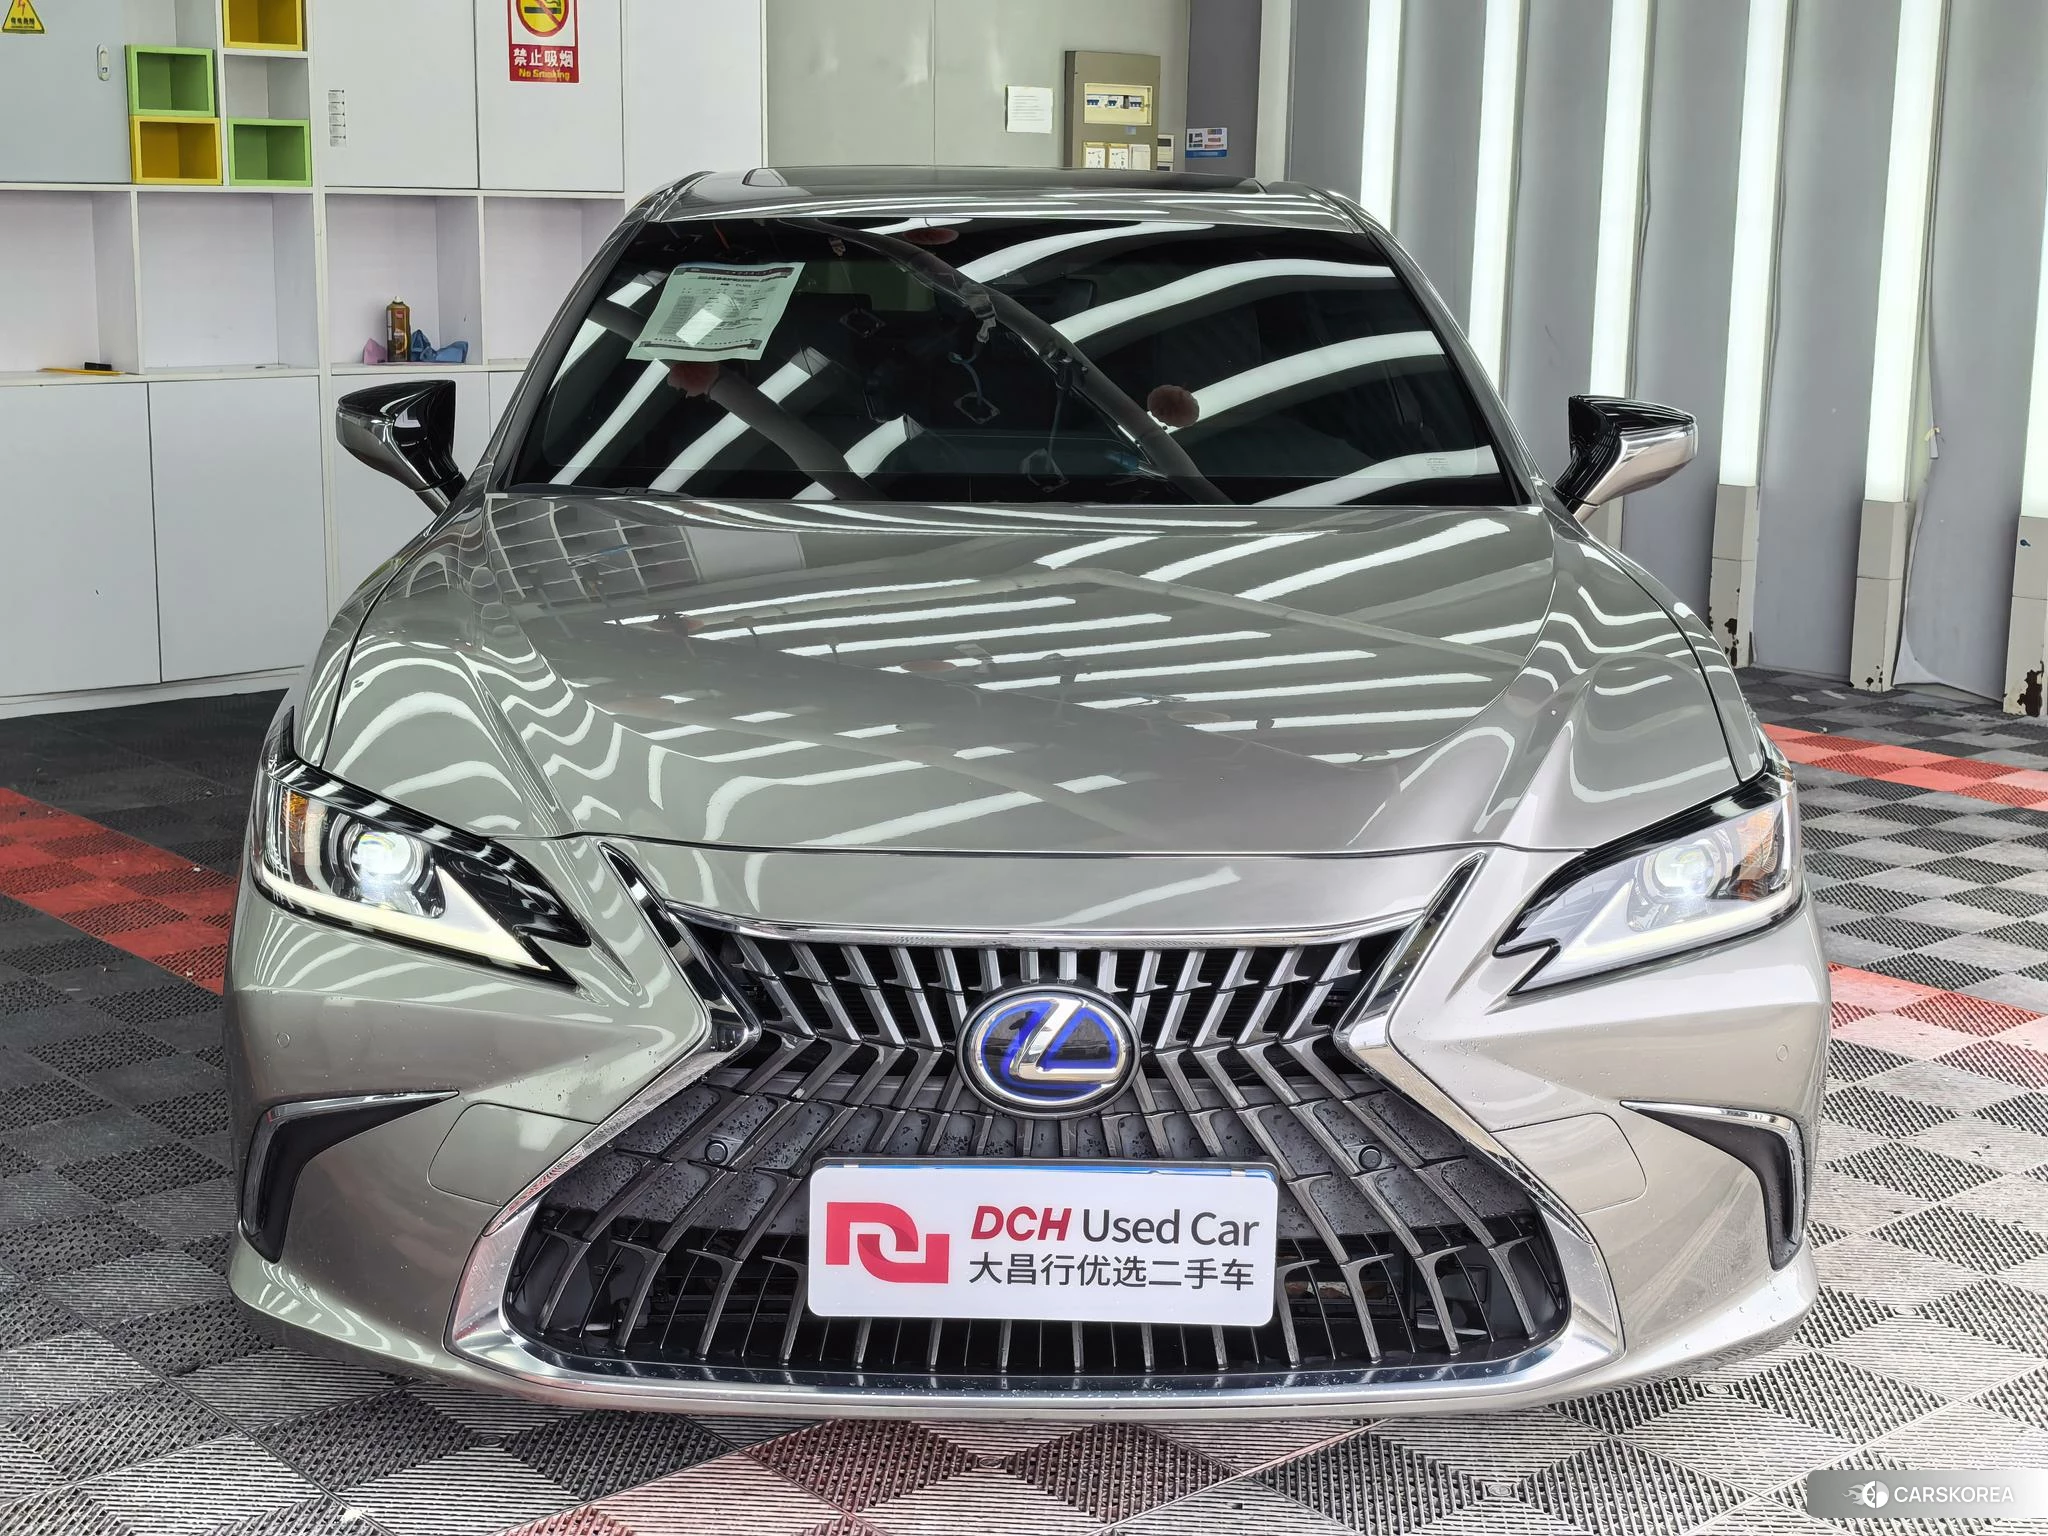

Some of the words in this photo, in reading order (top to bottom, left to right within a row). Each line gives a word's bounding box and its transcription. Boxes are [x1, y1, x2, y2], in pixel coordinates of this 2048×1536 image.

[513, 48, 574, 68] 禁止吸烟
[518, 68, 531, 77] No
[533, 69, 570, 81] Smoking
[971, 1205, 1072, 1241] DCH
[1083, 1208, 1180, 1244] Used
[1191, 1211, 1259, 1246] Car
[969, 1252, 1254, 1291] 大昌行优选二手车
